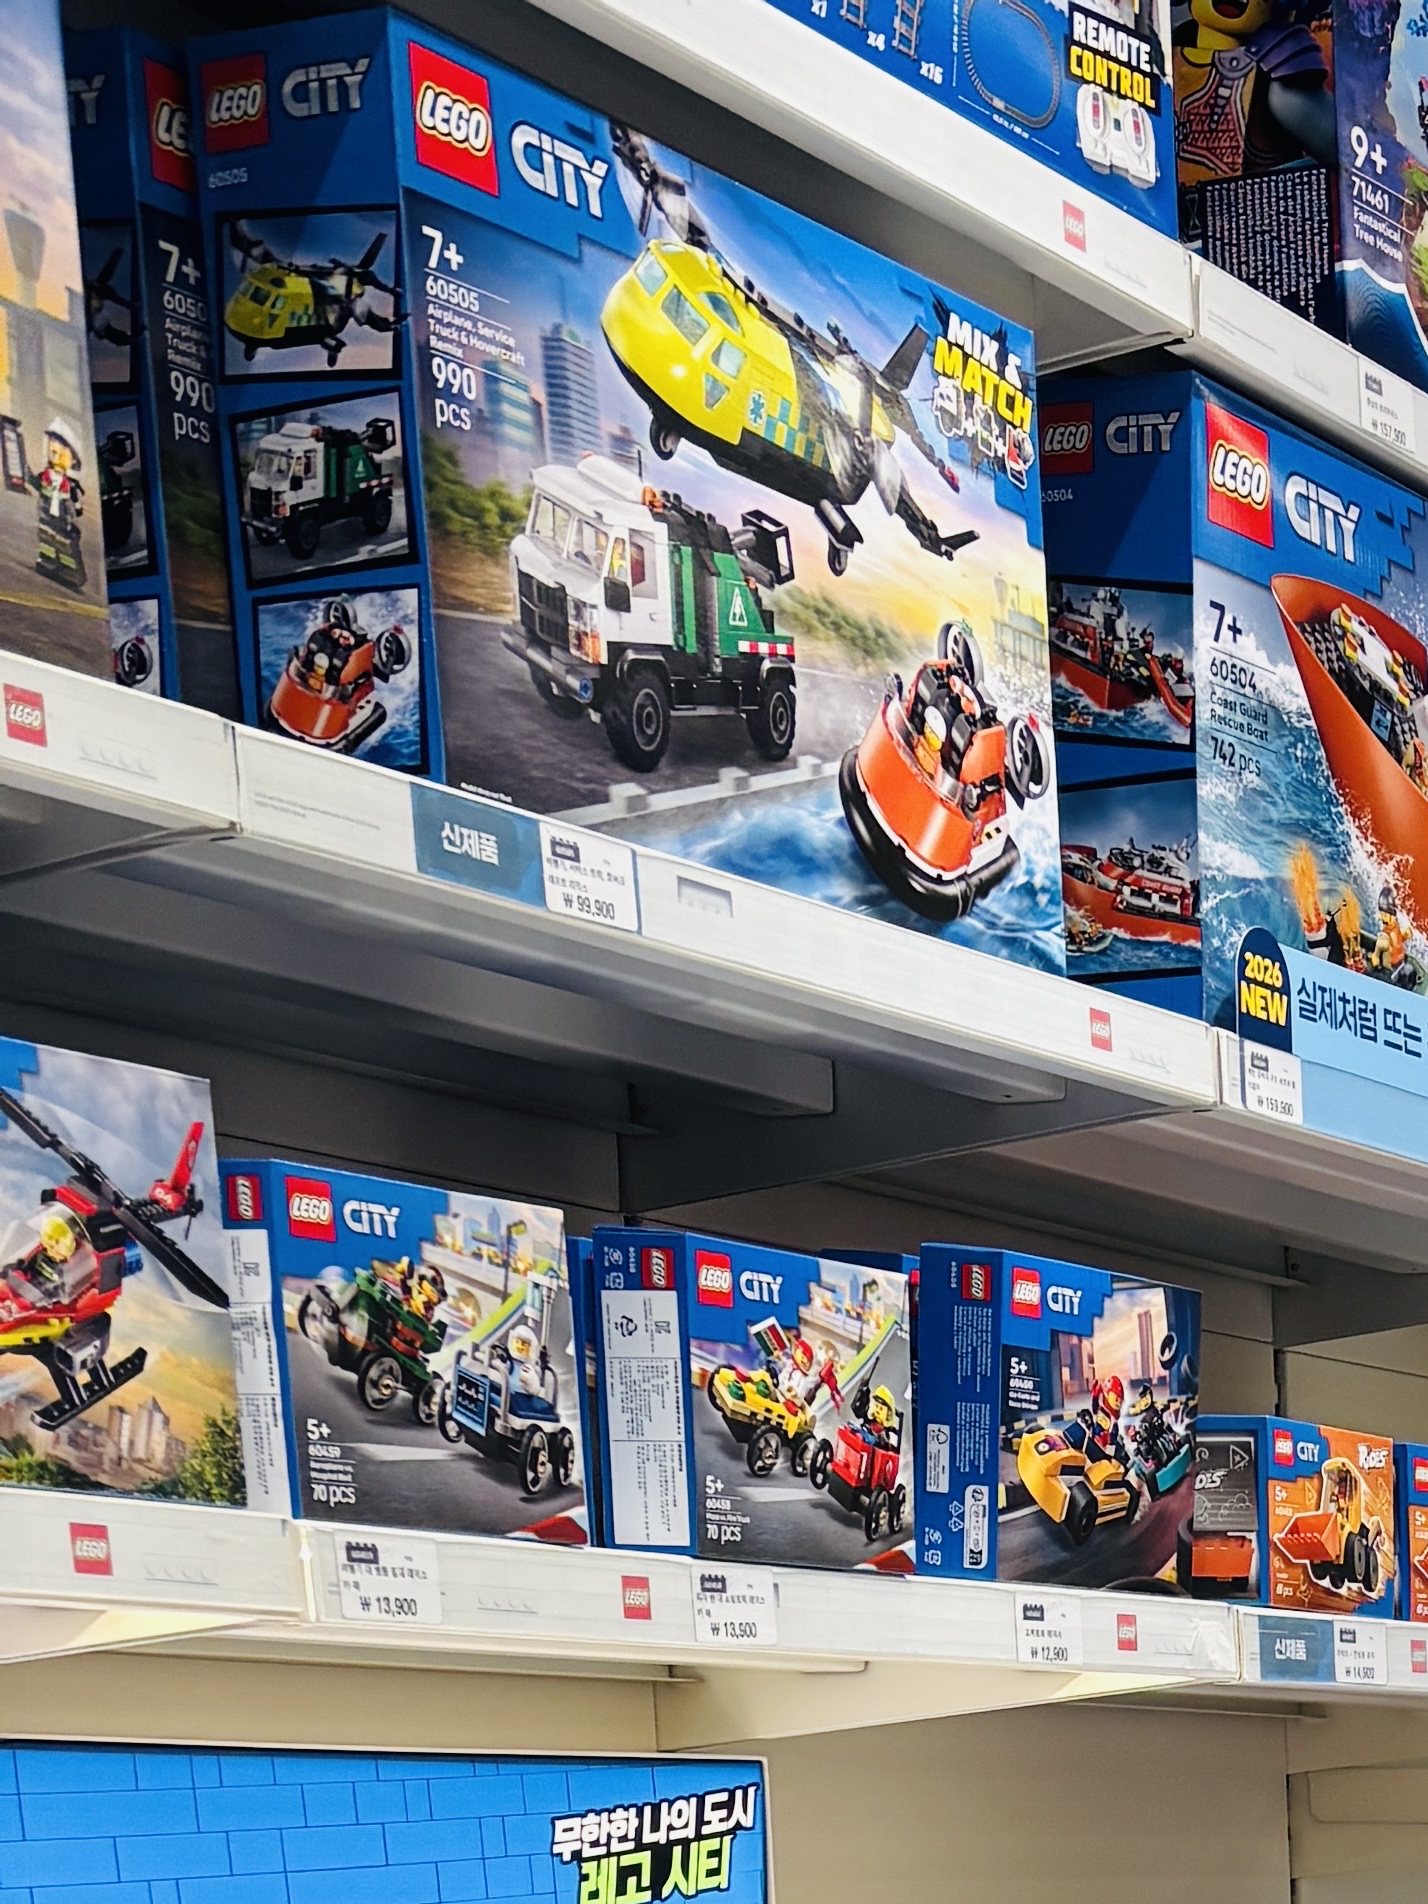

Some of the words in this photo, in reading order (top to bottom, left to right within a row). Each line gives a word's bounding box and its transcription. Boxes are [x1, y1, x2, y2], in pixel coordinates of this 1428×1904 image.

[1072, 15, 1151, 70] REMOTE
[920, 61, 943, 84] x16
[1069, 45, 1156, 109] CONTROL
[209, 83, 262, 124] LEGO
[418, 85, 492, 156] LEGO
[1350, 126, 1387, 174] 9+
[1351, 175, 1389, 214] 71461
[1353, 205, 1400, 242] Fantastical
[1354, 224, 1375, 247] Tree
[421, 224, 464, 271] 7+
[426, 276, 479, 313] 60505
[947, 312, 999, 366] MIX
[431, 358, 477, 401] 990
[934, 339, 1033, 433] MATCH
[434, 399, 472, 431] pcs
[1043, 424, 1089, 452] LEGO
[1209, 440, 1269, 510] LEGO
[1208, 600, 1243, 645] 7+
[1208, 656, 1257, 693] 60504
[1209, 689, 1237, 721] Coast
[1238, 701, 1269, 725] Guard
[1209, 709, 1243, 735] Rescue
[1209, 735, 1236, 771] 742
[1238, 750, 1261, 777] pcs
[440, 821, 500, 866] 신제품
[577, 895, 615, 920] 99,900
[1243, 951, 1284, 989] 2026
[1240, 978, 1288, 1026] NEW
[1297, 977, 1378, 1043] 실제처럼
[1383, 1007, 1422, 1058] 뜨는
[237, 1177, 253, 1219] LEGO
[290, 1193, 332, 1224] LEGO
[651, 1250, 666, 1288] LEGO
[700, 1267, 732, 1292] LEGO
[972, 1265, 984, 1298] LEGO
[1015, 1280, 1040, 1305] LEGO
[1010, 1358, 1028, 1374] 5+
[306, 1418, 331, 1440] 5+
[329, 1487, 356, 1506] pcs
[705, 1475, 724, 1494] 5+
[74, 1536, 107, 1561] LEGO
[721, 1526, 741, 1544] pcs
[375, 1597, 418, 1617] 13,900
[624, 1588, 650, 1608] LEGO
[1274, 1638, 1308, 1662] 신제품
[552, 1807, 639, 1861] 무한한
[642, 1797, 698, 1844] 나의
[701, 1786, 757, 1834] 도시
[662, 1835, 734, 1899] 시티
